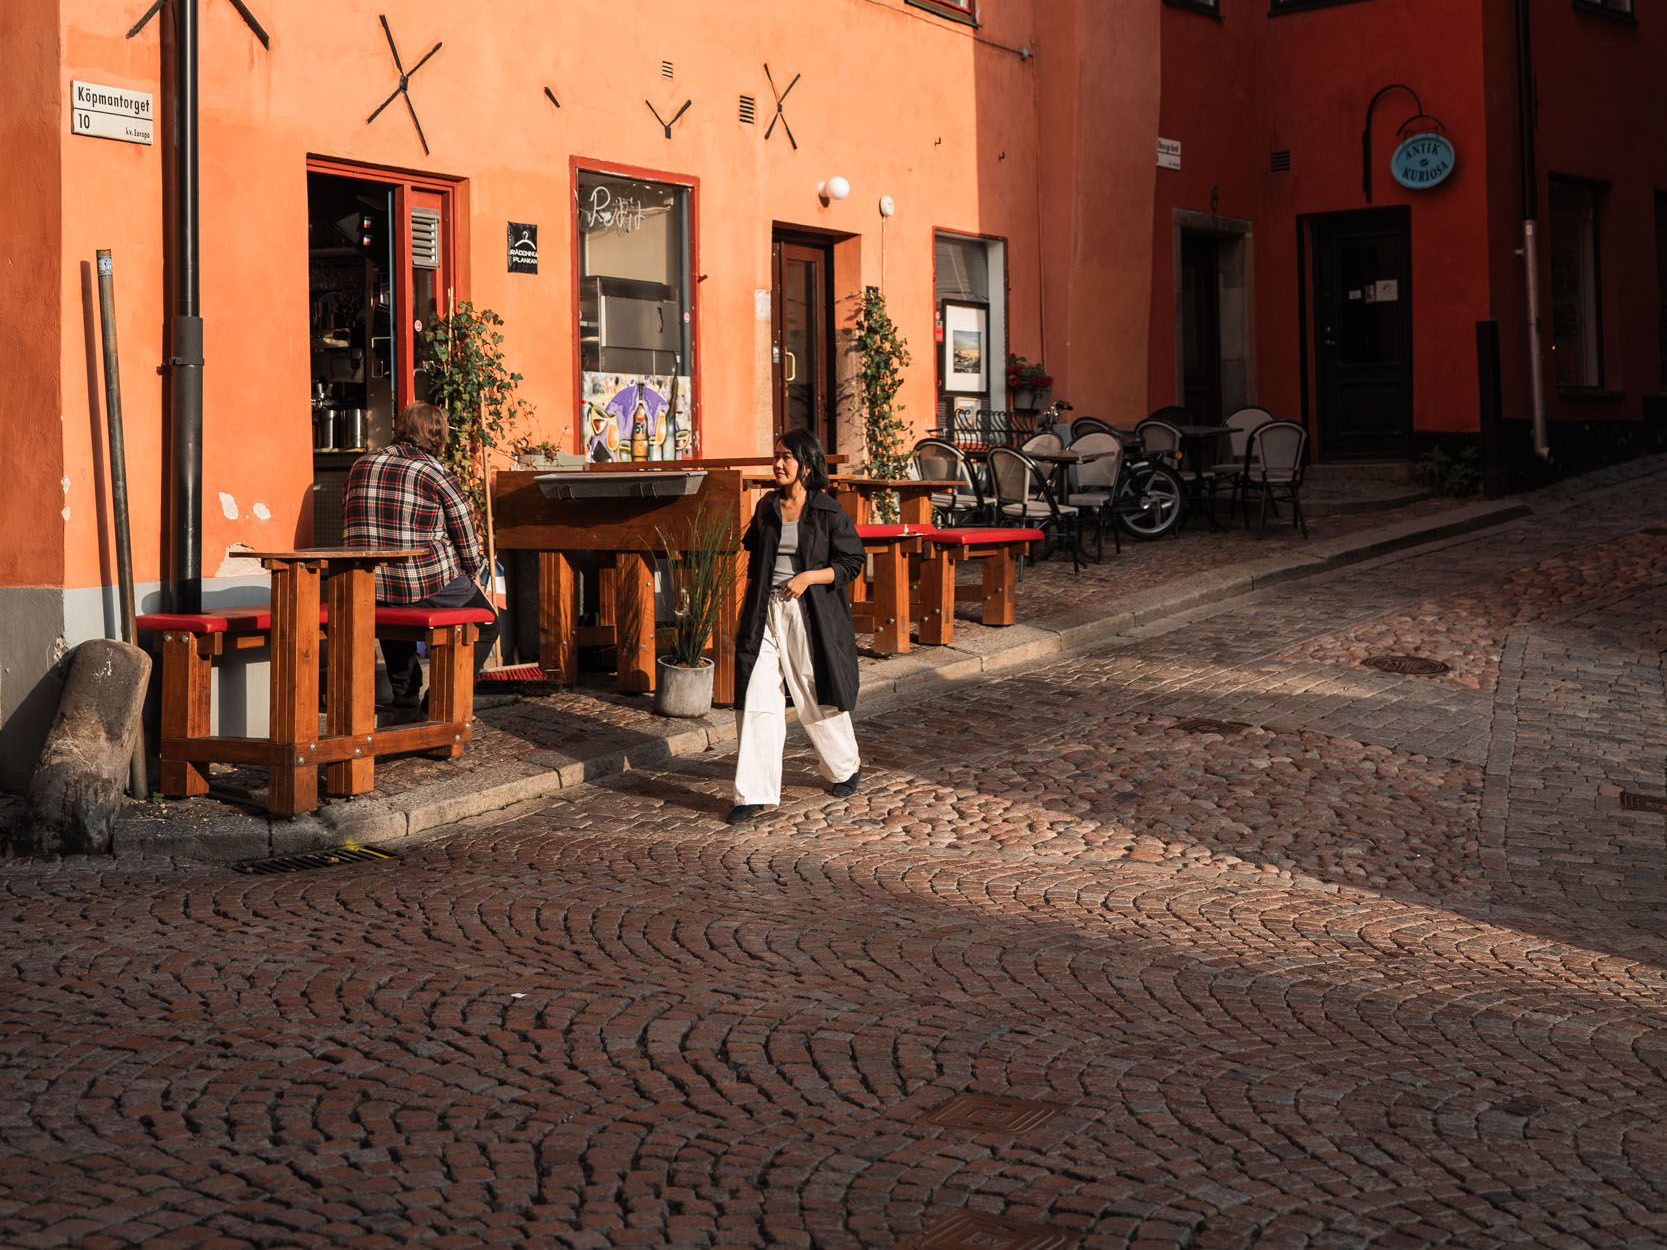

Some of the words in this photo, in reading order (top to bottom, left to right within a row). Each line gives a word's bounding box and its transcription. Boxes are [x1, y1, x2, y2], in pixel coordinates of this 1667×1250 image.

[78, 86, 150, 115] Köpmantorget
[78, 113, 90, 129] 10
[1405, 142, 1440, 159] ANTIK
[1402, 160, 1449, 181] KURIOSA
[634, 422, 645, 435] 51
